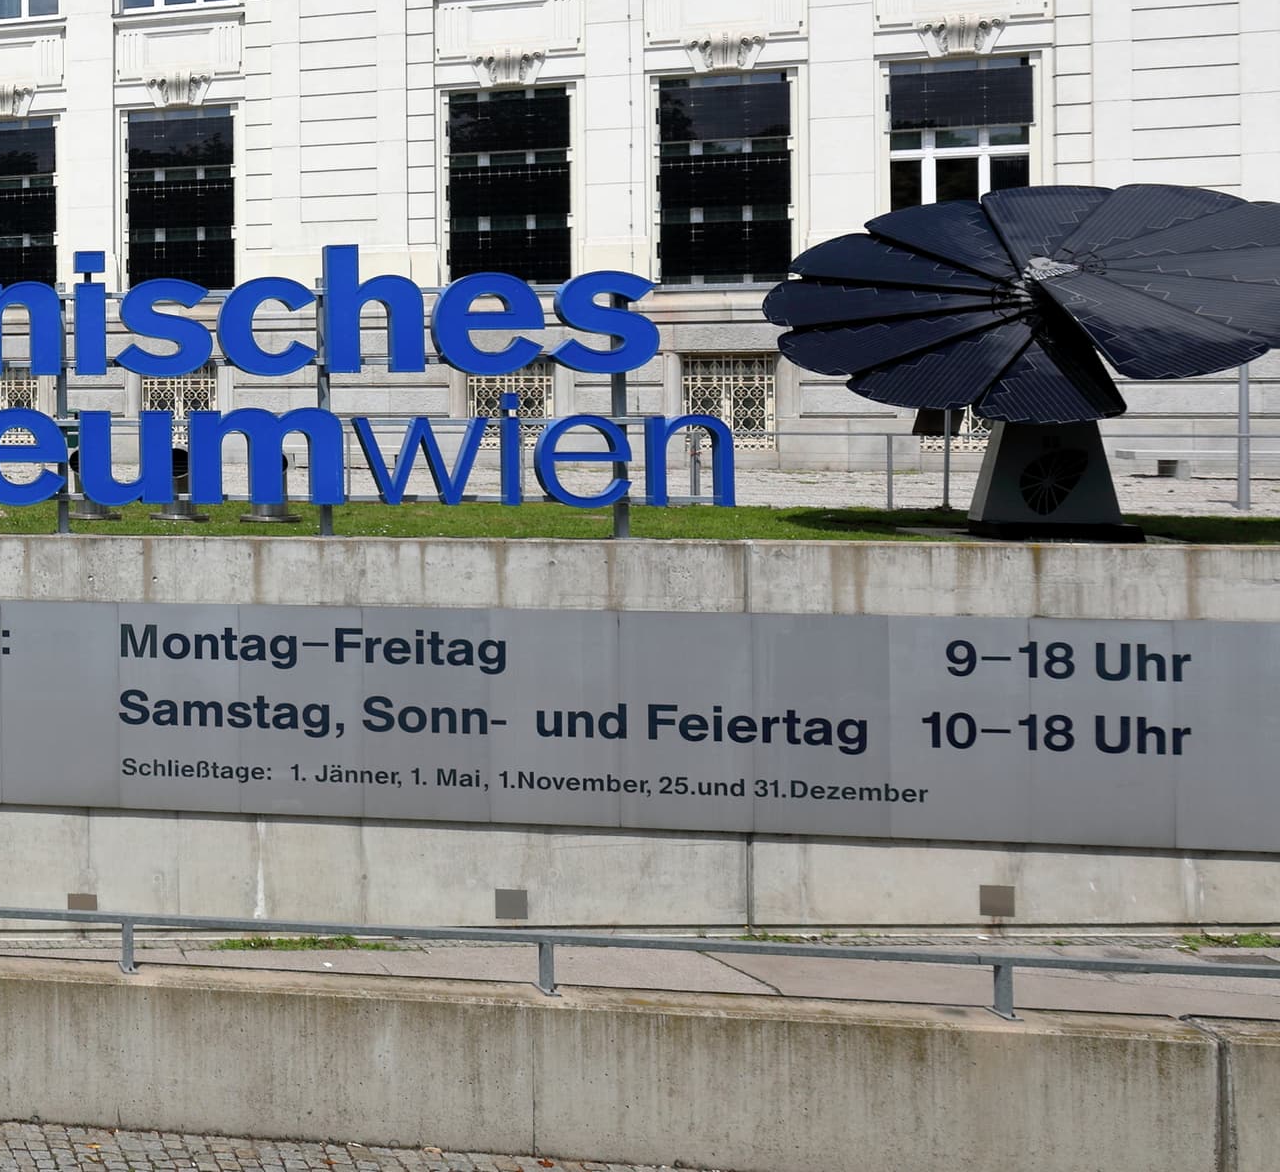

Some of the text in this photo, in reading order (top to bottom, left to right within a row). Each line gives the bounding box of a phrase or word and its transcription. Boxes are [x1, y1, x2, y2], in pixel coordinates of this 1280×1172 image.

[1095, 642, 1192, 683] Uhr
[118, 689, 868, 756] Samstag, Sonn- und Feiertag
[1094, 714, 1192, 756] Uhr
[121, 757, 273, 784] Schließtage:
[290, 763, 308, 782] 1.
[314, 763, 402, 789] Jänner,
[410, 767, 428, 786] 1.
